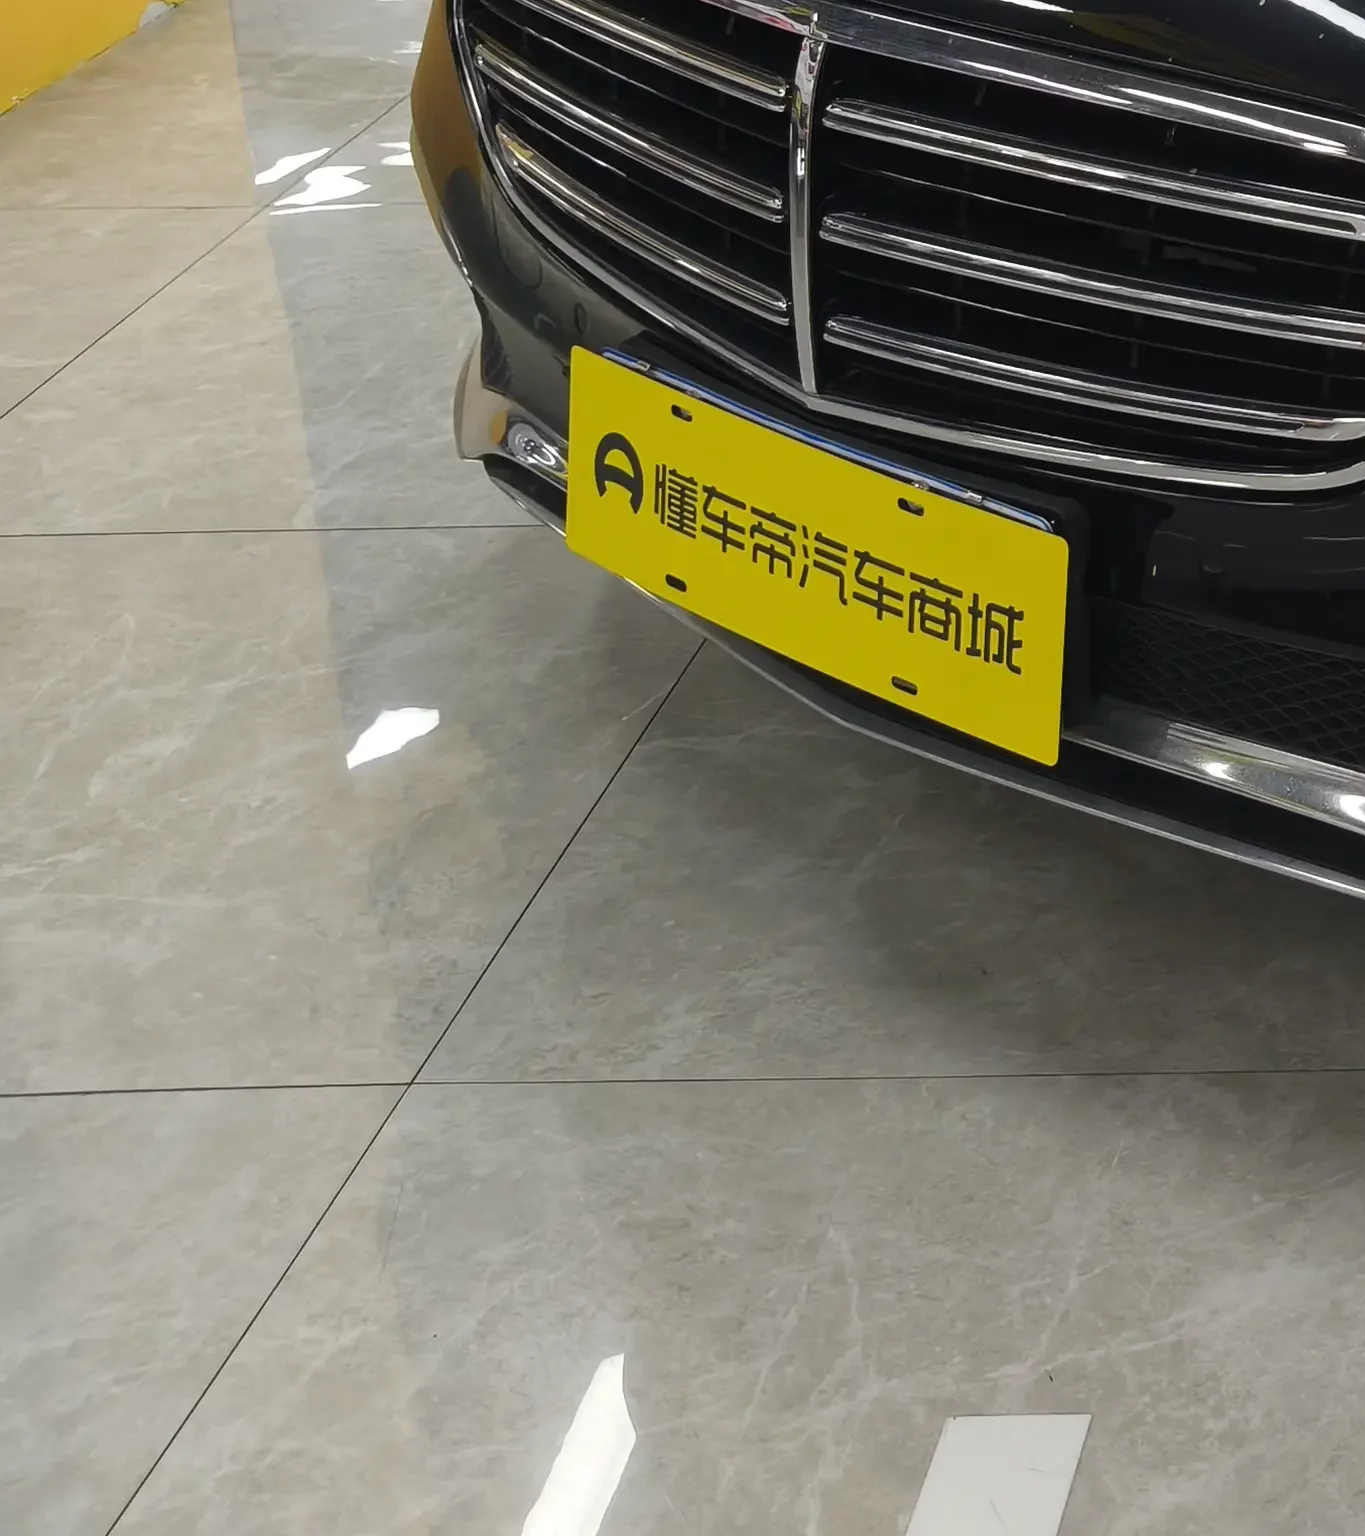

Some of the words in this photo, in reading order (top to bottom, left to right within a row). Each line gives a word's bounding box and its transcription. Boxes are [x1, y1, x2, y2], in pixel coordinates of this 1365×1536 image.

[654, 463, 1024, 675] 懂车帝汽车商城
